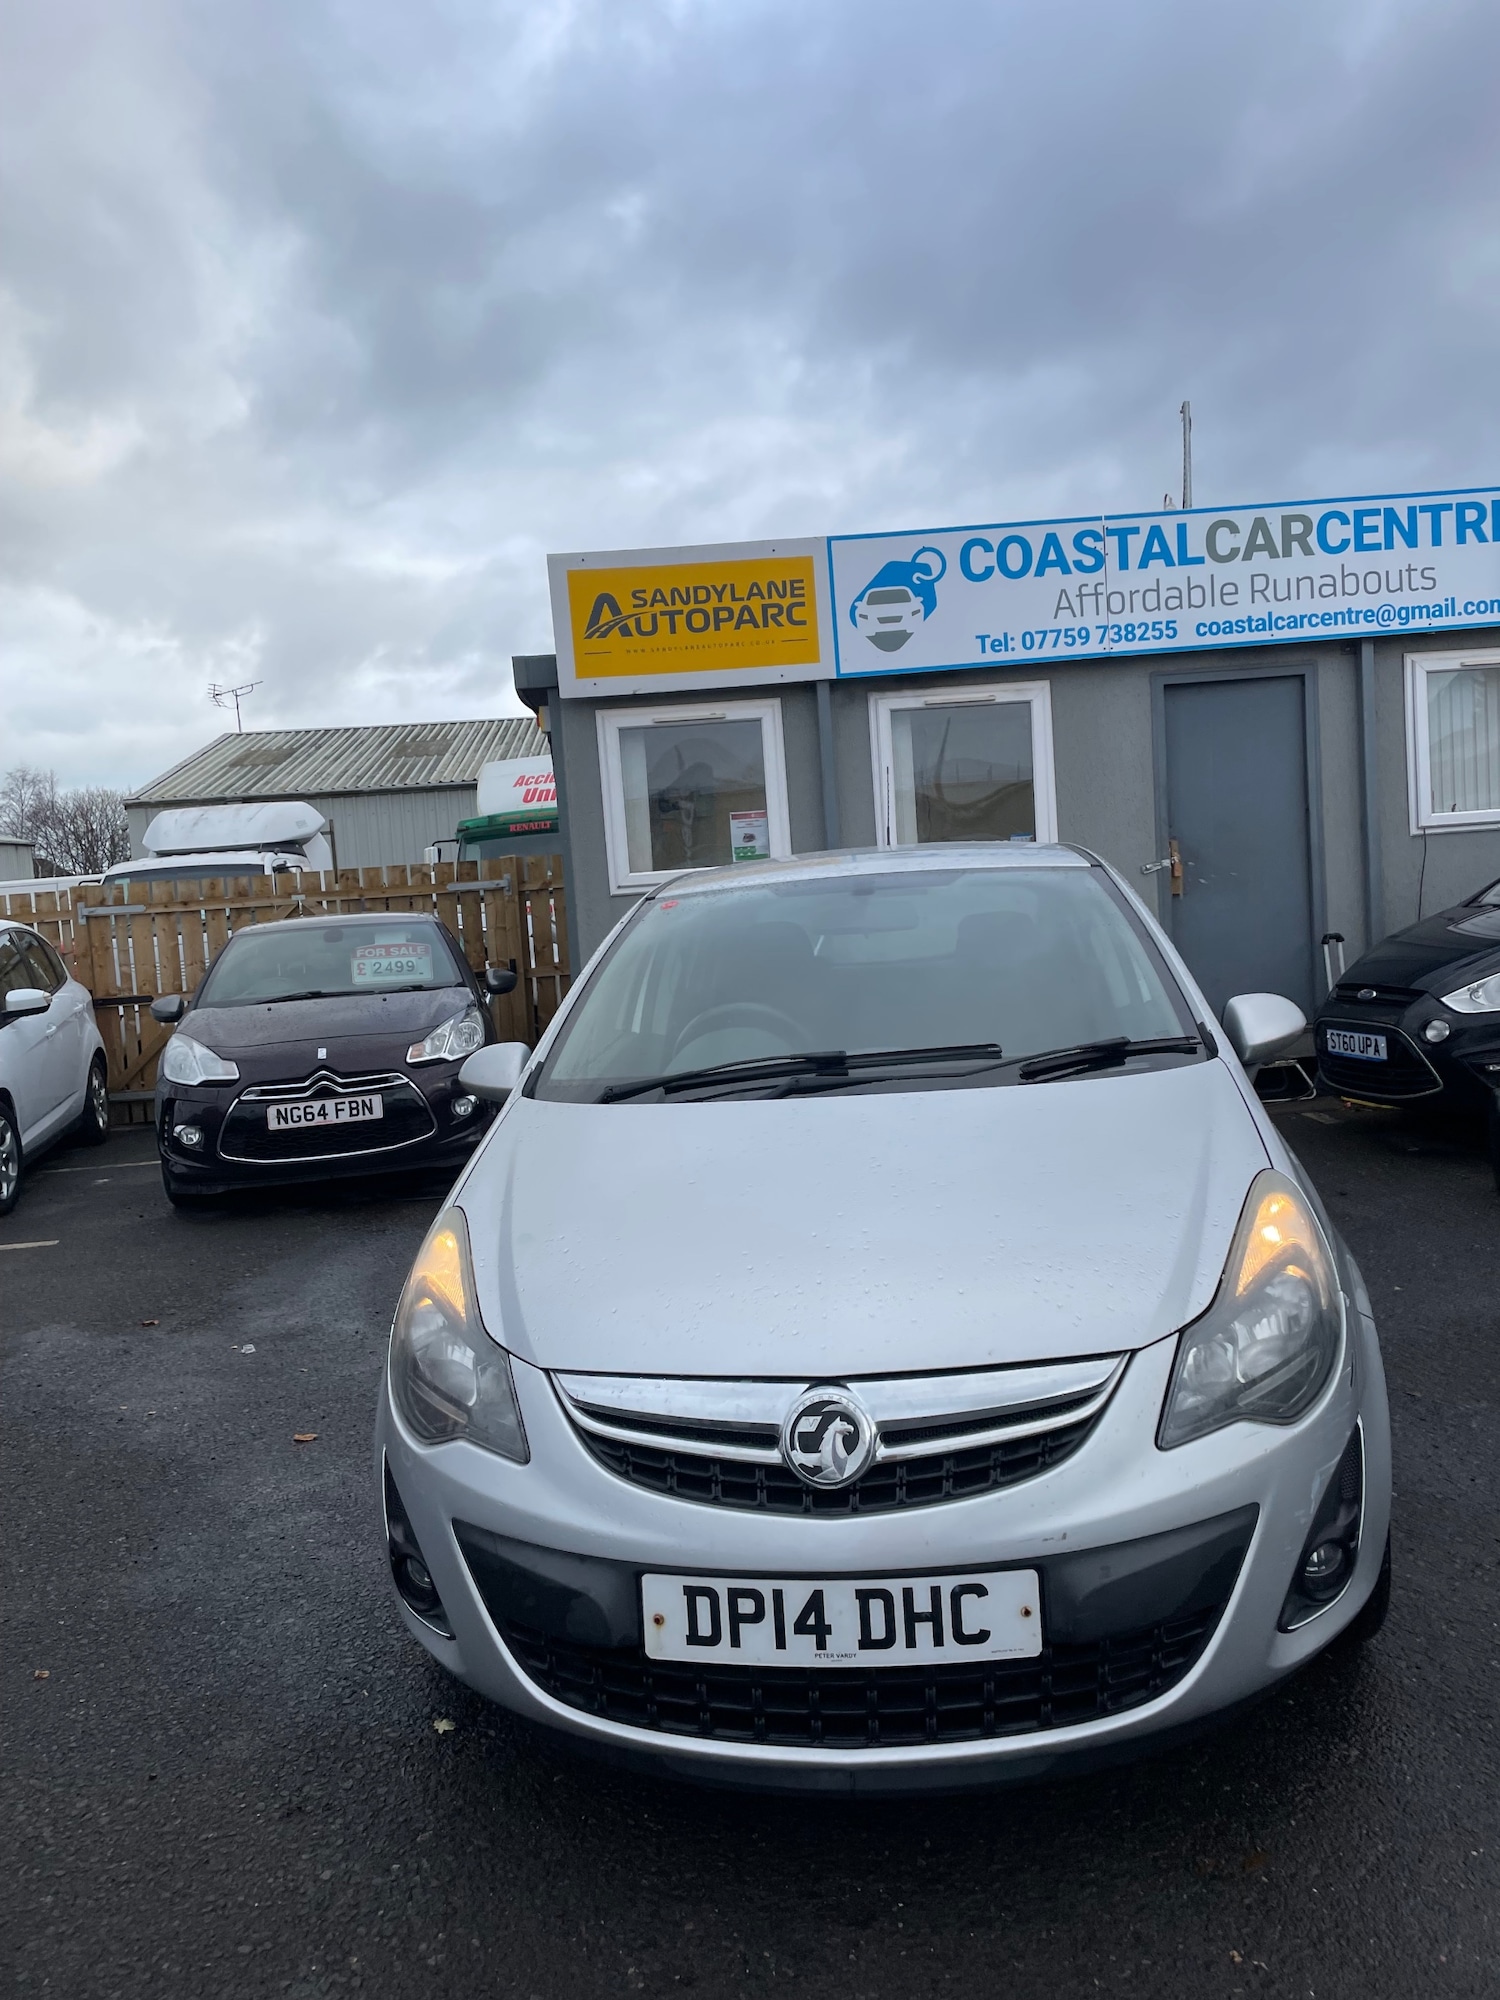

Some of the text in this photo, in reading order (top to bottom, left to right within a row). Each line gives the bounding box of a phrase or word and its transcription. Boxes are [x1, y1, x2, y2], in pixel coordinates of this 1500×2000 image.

[631, 579, 806, 608] SANDYLANE
[1053, 563, 1437, 620] Affordable Runabouts
[584, 592, 807, 639] AUTOPARC
[975, 620, 1178, 654] Tel: 07759 738255
[509, 821, 552, 832] RENAULT
[356, 945, 426, 957] FOR SALE
[373, 960, 416, 974] 2499
[1330, 1031, 1381, 1057] ST60 UPA
[275, 1098, 374, 1126] NG64 FBN
[682, 1582, 992, 1651] DP14 DHC
